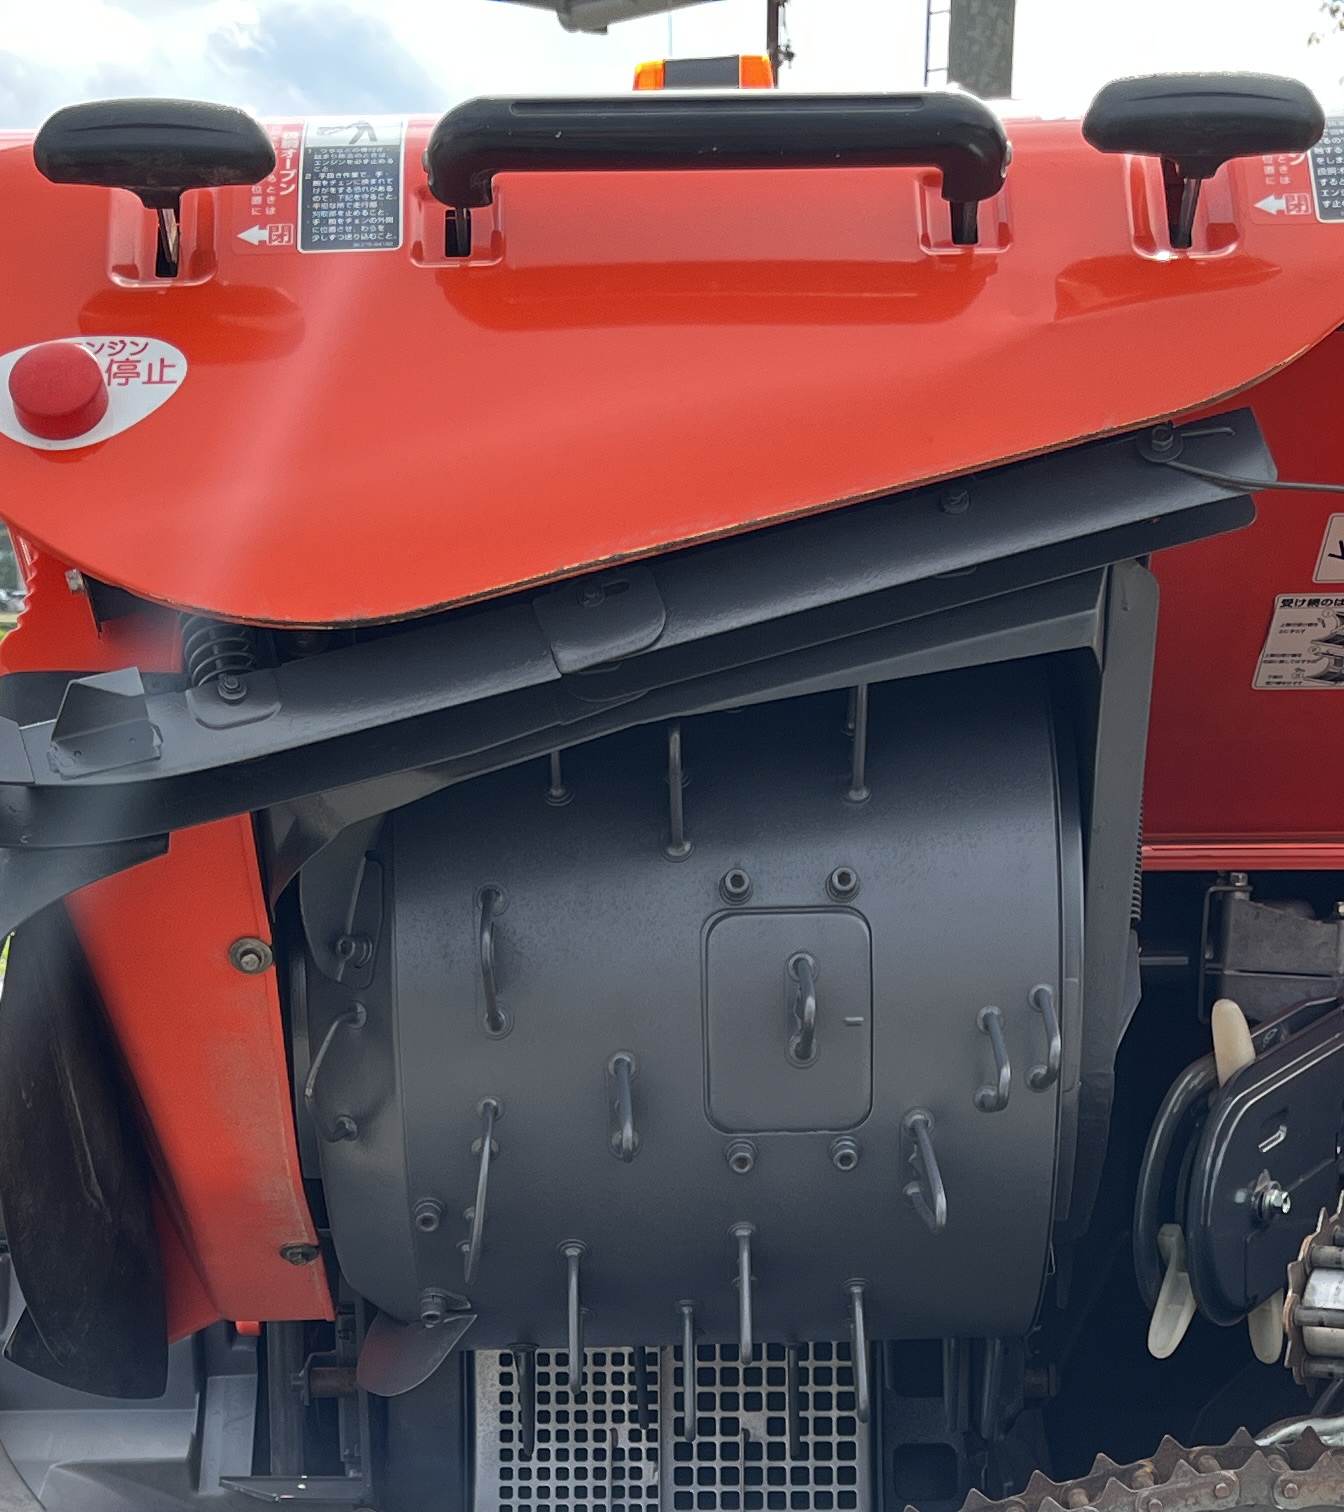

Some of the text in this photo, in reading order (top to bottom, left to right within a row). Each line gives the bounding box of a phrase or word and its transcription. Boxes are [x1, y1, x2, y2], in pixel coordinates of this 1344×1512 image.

[77, 340, 149, 357] ンジン
[105, 357, 178, 387] 停止
